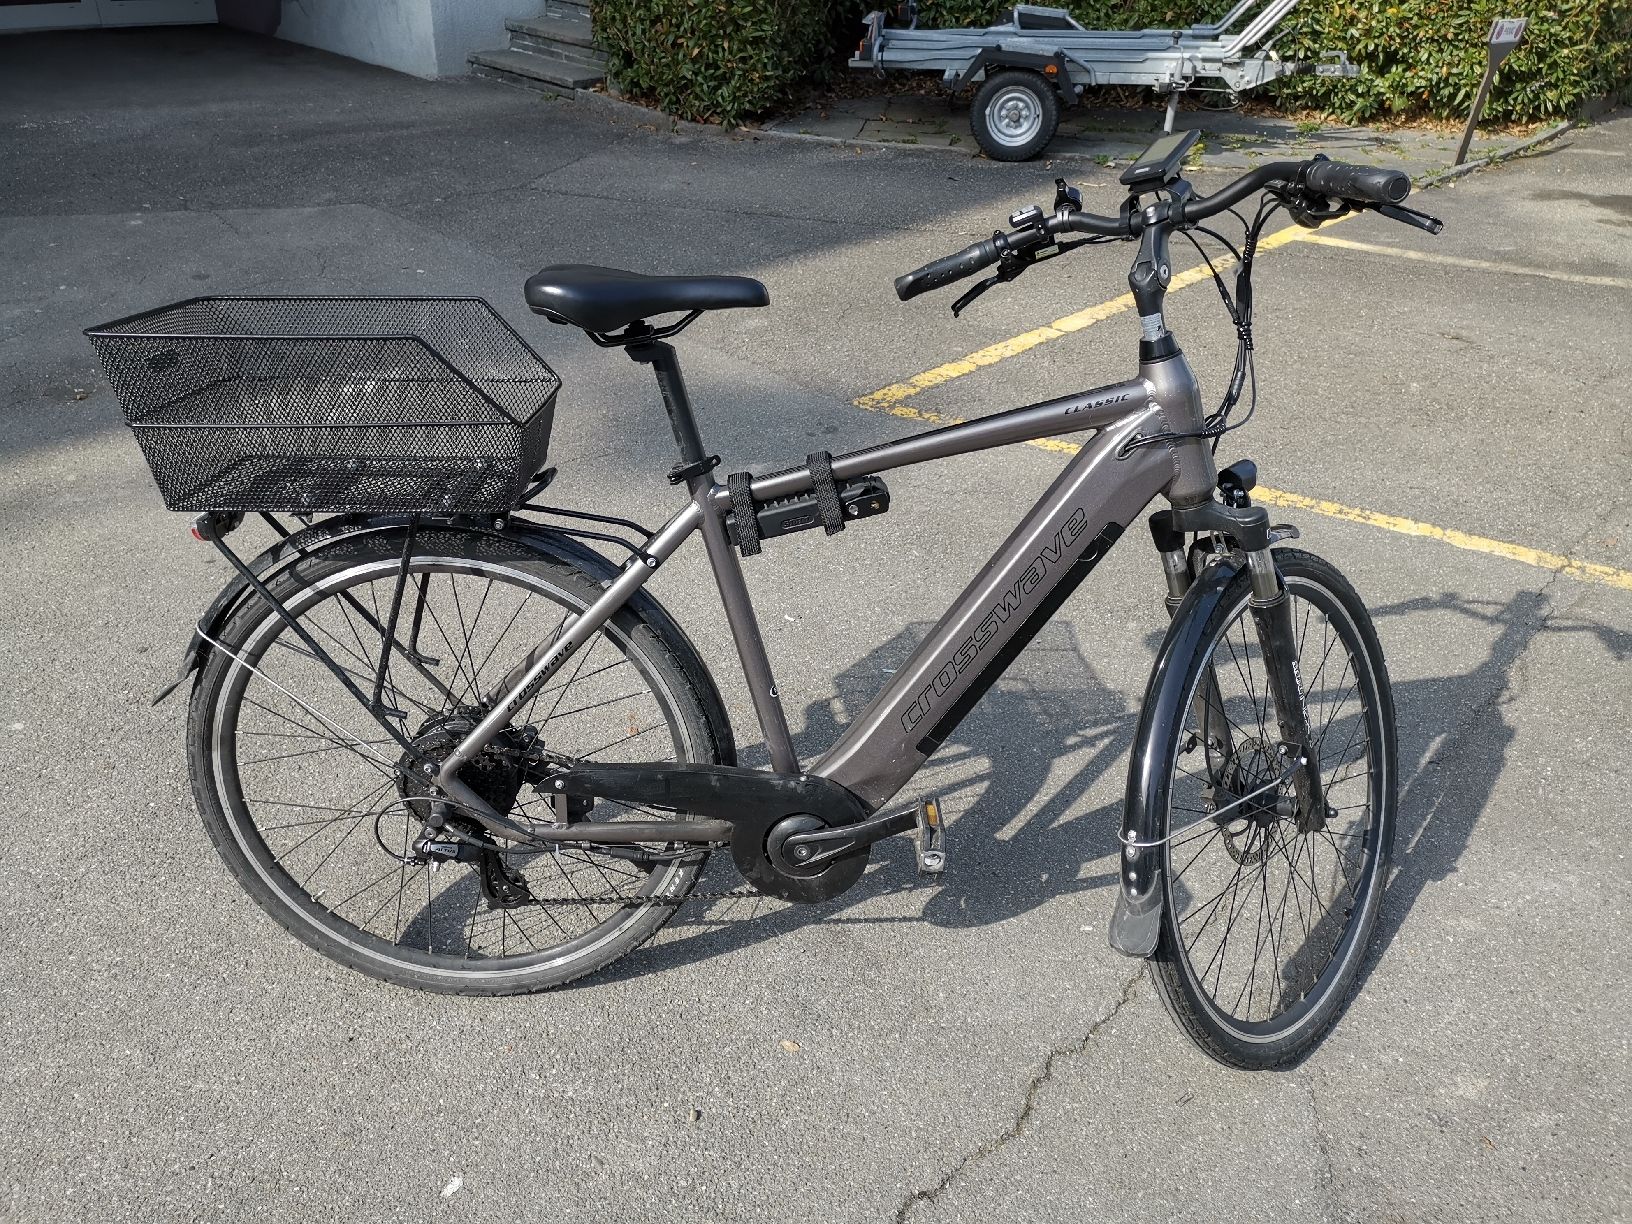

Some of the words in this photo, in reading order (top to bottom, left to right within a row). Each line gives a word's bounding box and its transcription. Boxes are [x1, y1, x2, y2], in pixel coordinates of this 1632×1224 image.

[1064, 393, 1130, 415] CLASSIC
[901, 507, 1088, 733] crosswave
[507, 641, 573, 712] crosswave
